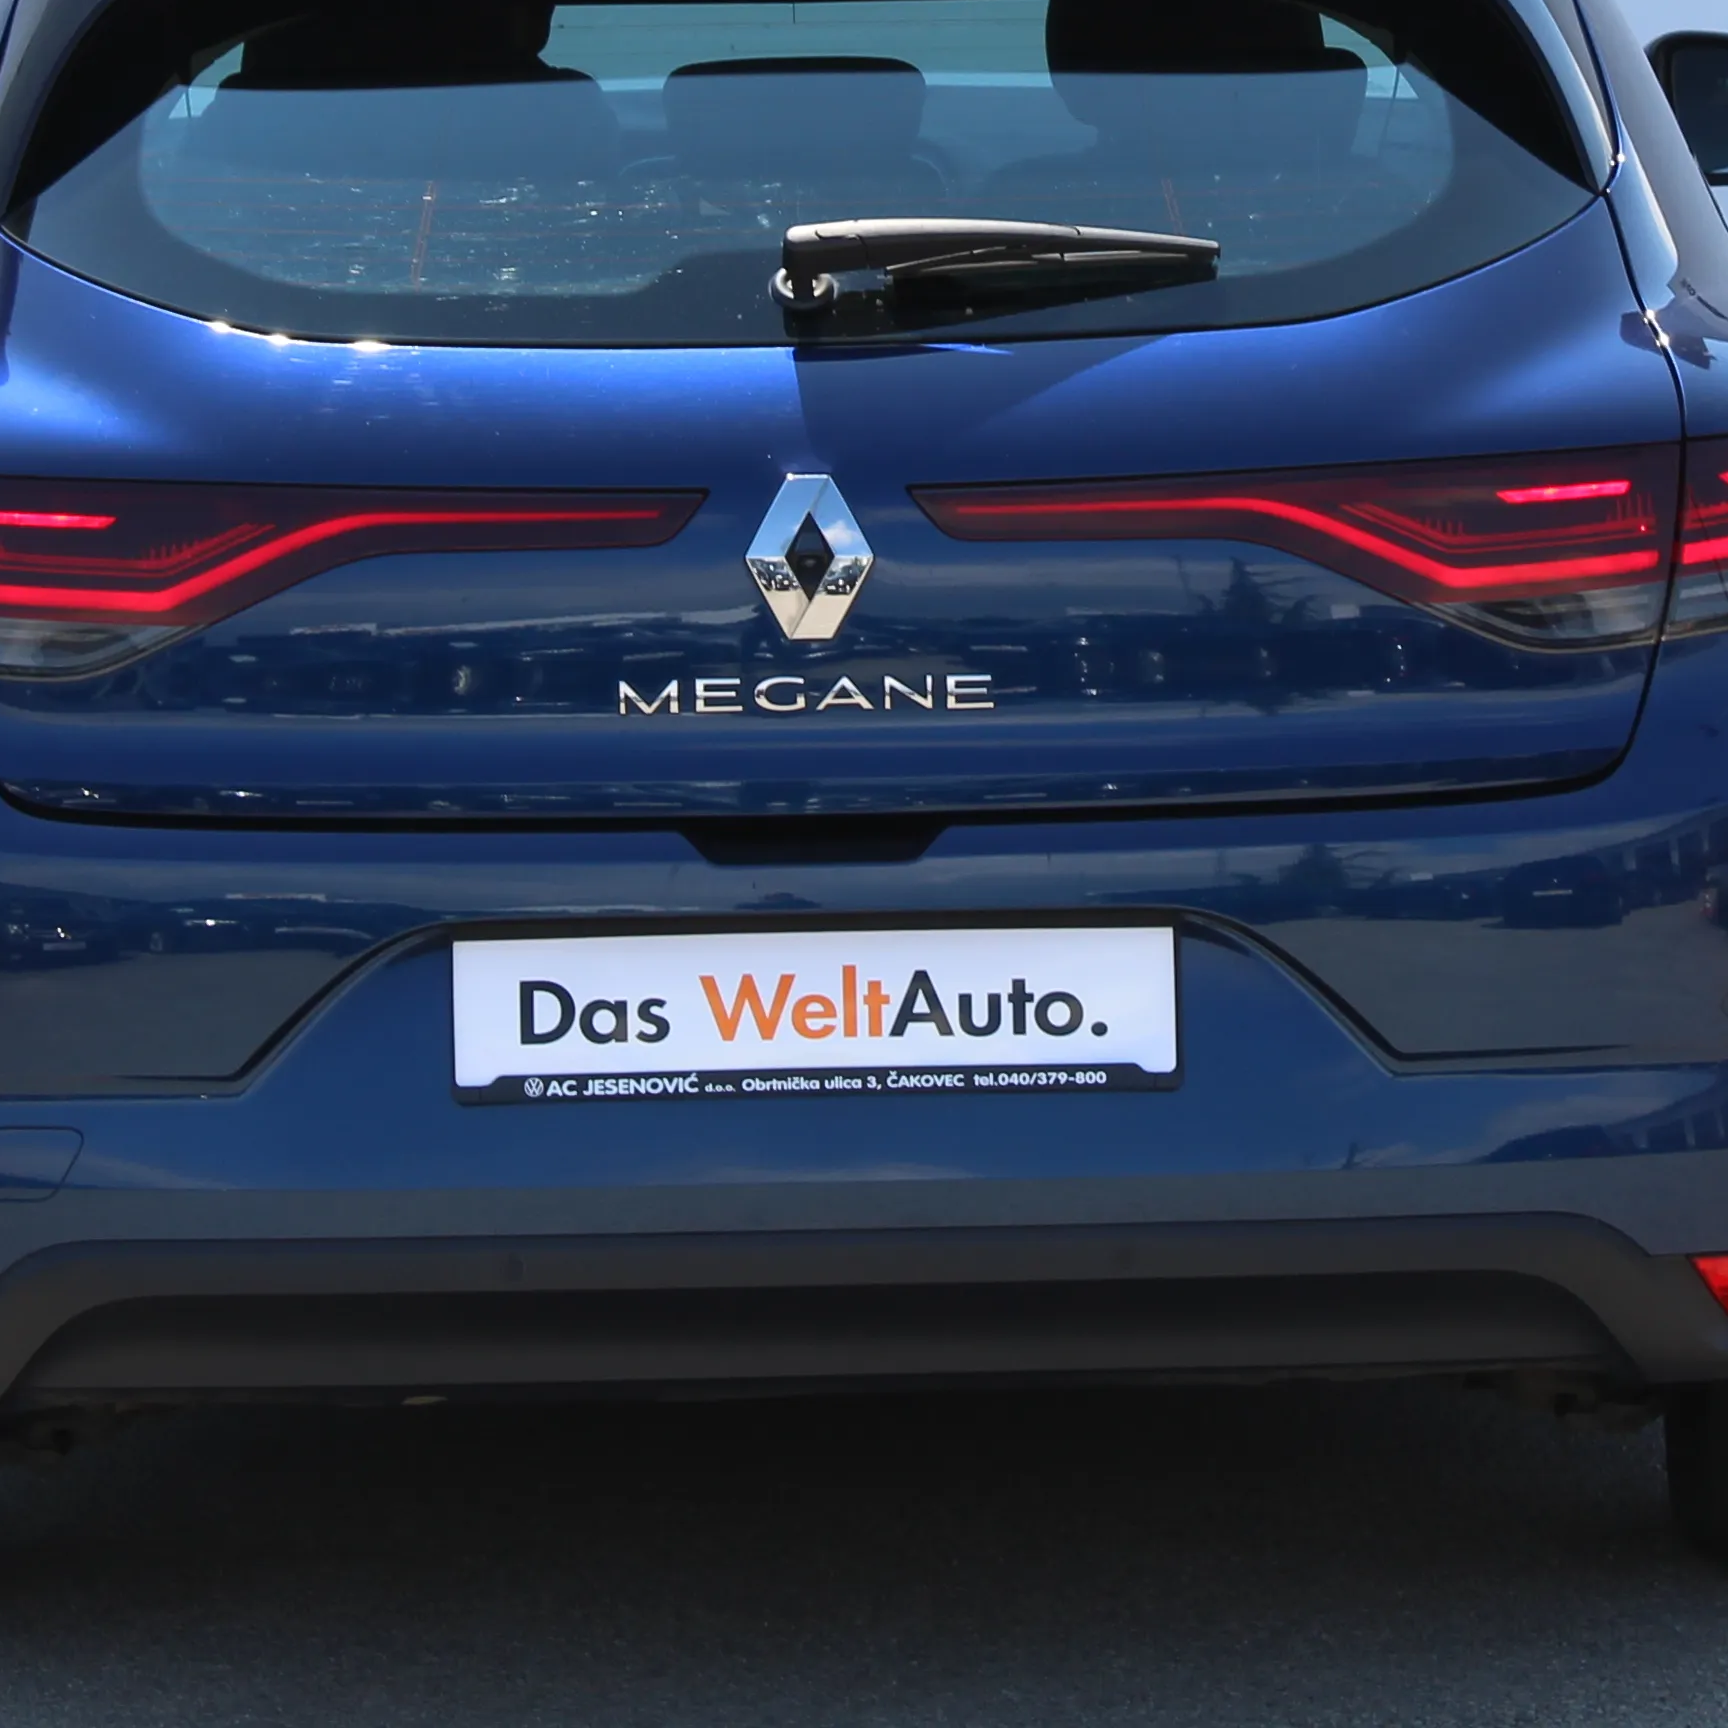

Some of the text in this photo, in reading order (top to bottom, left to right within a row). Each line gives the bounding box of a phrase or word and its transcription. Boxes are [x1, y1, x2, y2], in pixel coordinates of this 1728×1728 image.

[617, 673, 996, 717] MEGANE
[518, 963, 1109, 1046] Das WeltAuto.
[546, 1079, 578, 1097] AC
[582, 1072, 700, 1096] JESENOVIĆ
[704, 1082, 736, 1093] d.o.o.
[741, 1075, 821, 1092] Obrtnička
[824, 1075, 863, 1090] ulica
[866, 1075, 882, 1091] 3,
[886, 1070, 965, 1089] ČAKOVEC
[973, 1070, 1108, 1087] tel.040/379-800
